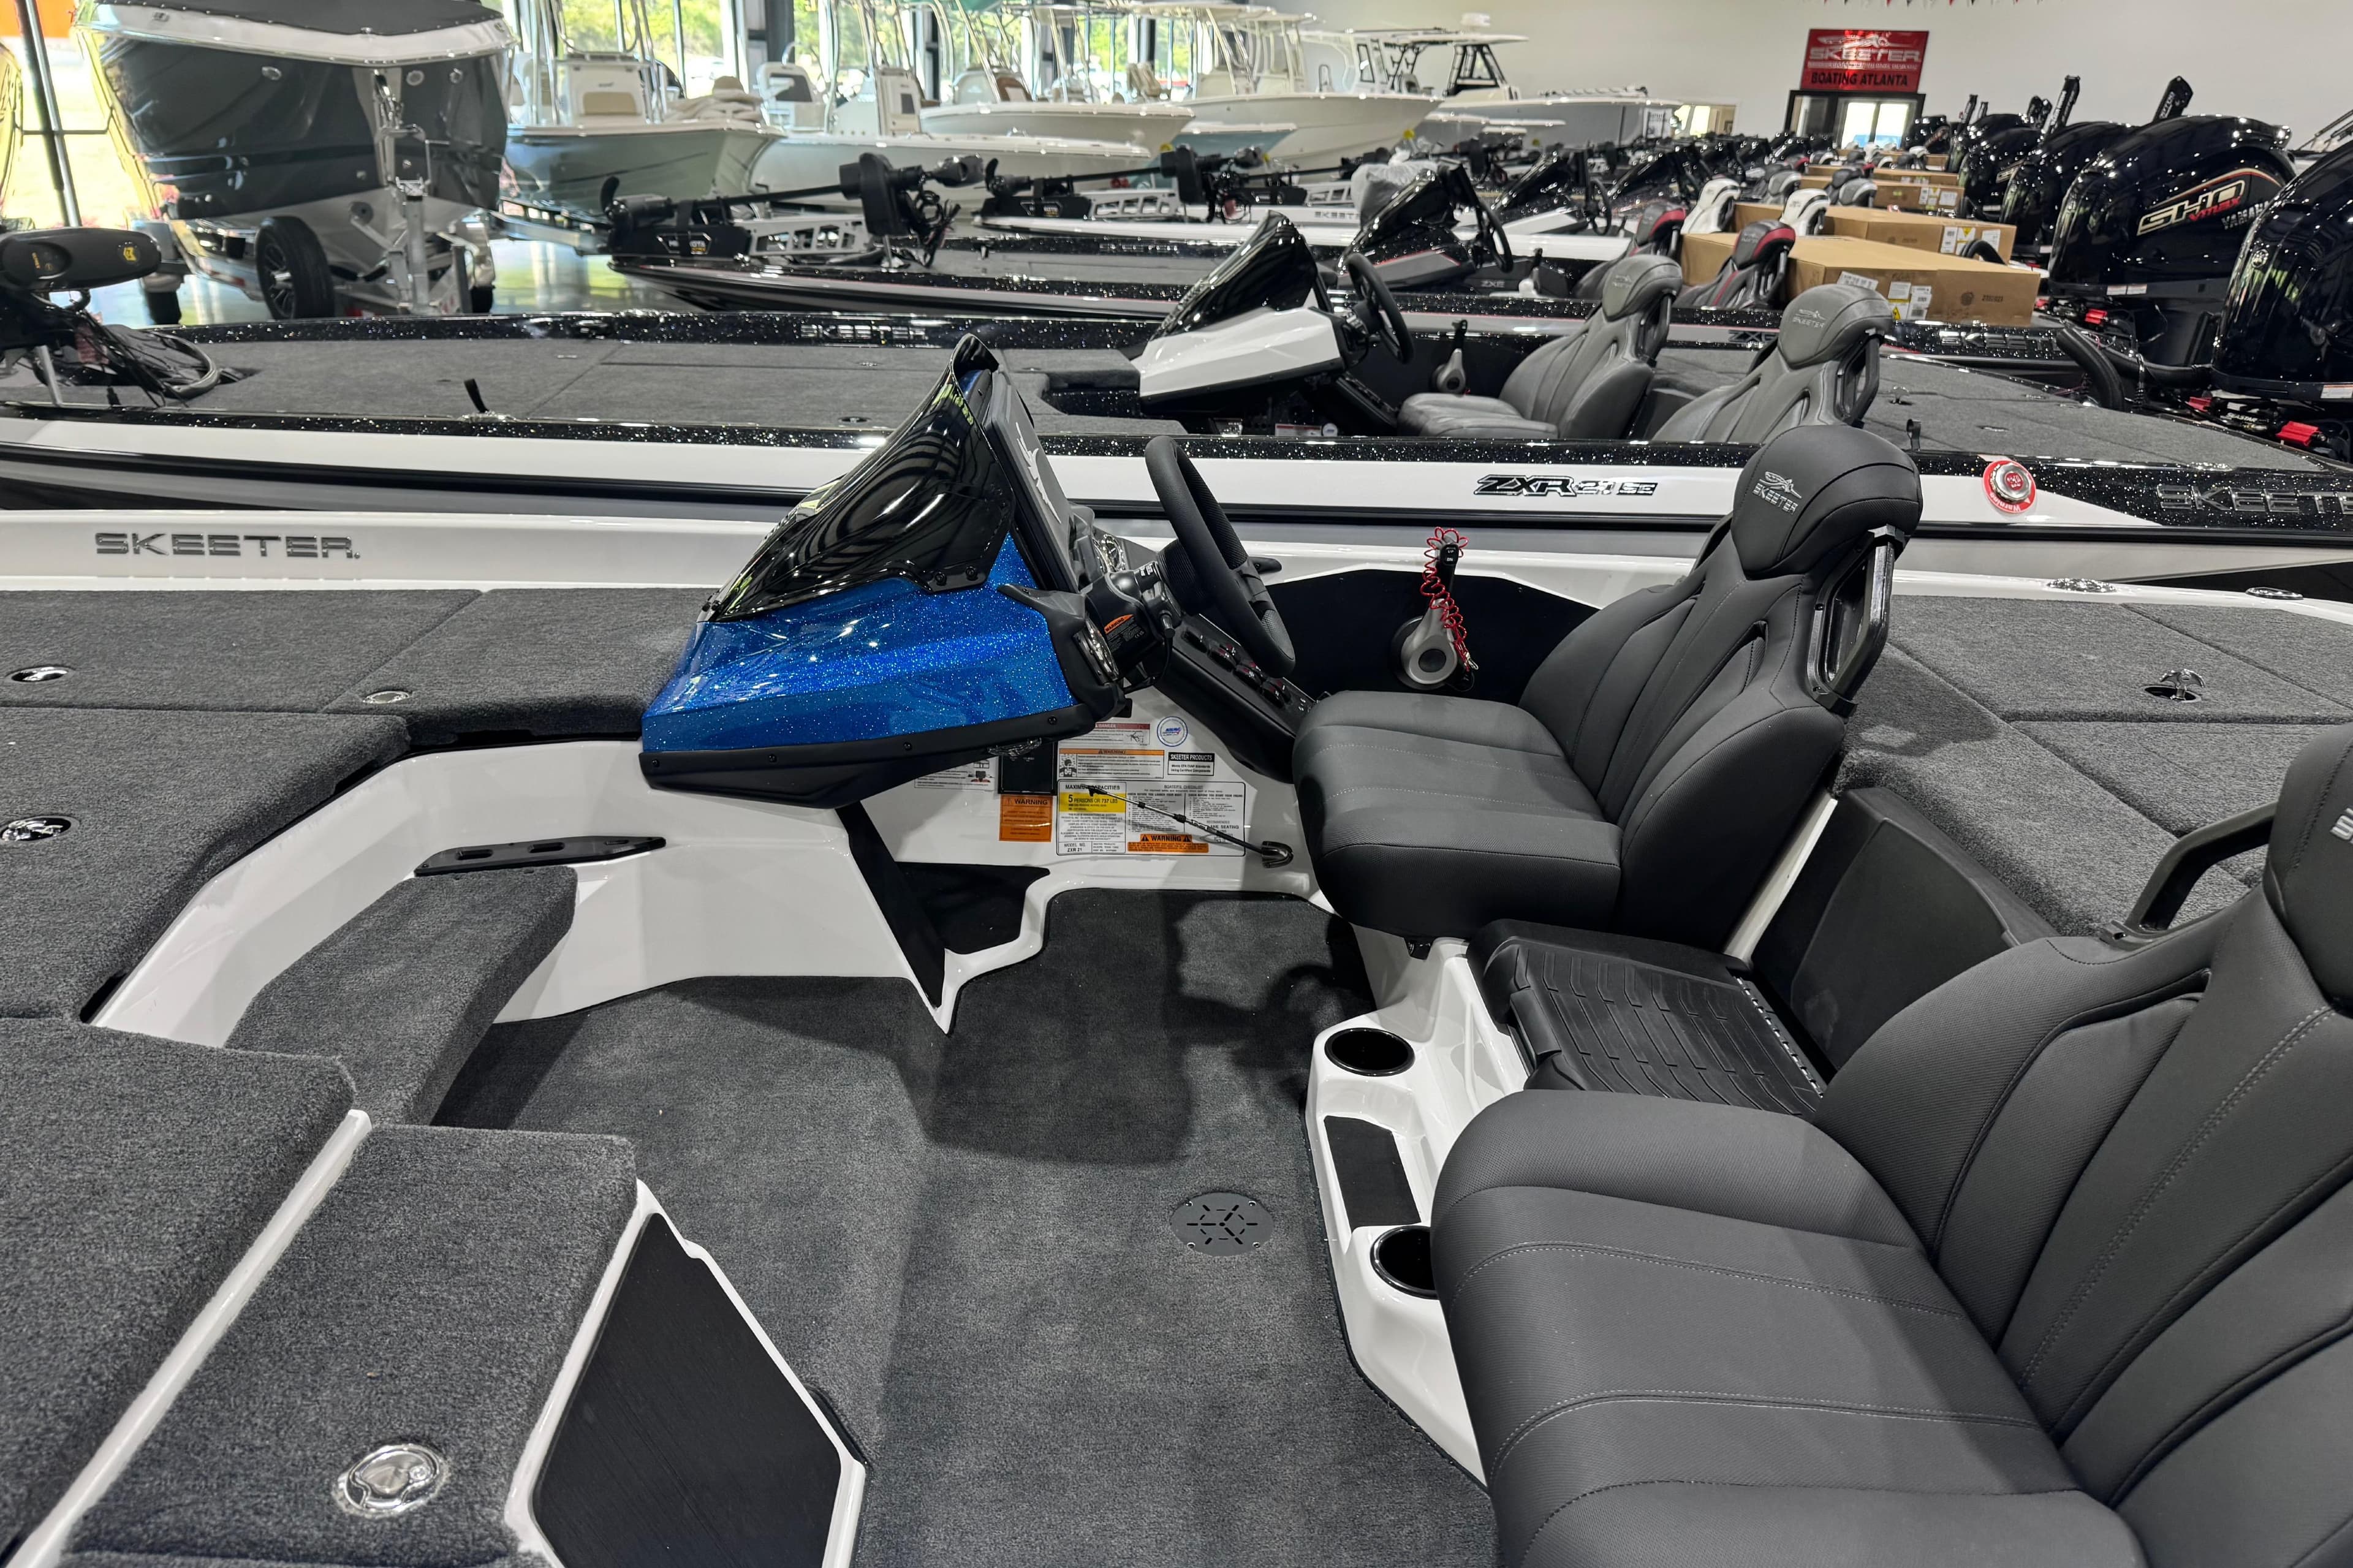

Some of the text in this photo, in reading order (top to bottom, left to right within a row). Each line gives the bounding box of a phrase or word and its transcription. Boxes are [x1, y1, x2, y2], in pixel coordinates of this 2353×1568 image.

[1809, 47, 1921, 62] SKEETER
[1811, 72, 1908, 87] BOATING ATLANTA
[2137, 180, 2246, 236] SHO
[2227, 412, 2257, 422] SEASTAR
[1474, 474, 1577, 497] ZXR
[1752, 483, 1799, 515] SKEETER
[1989, 491, 2021, 512] Warning
